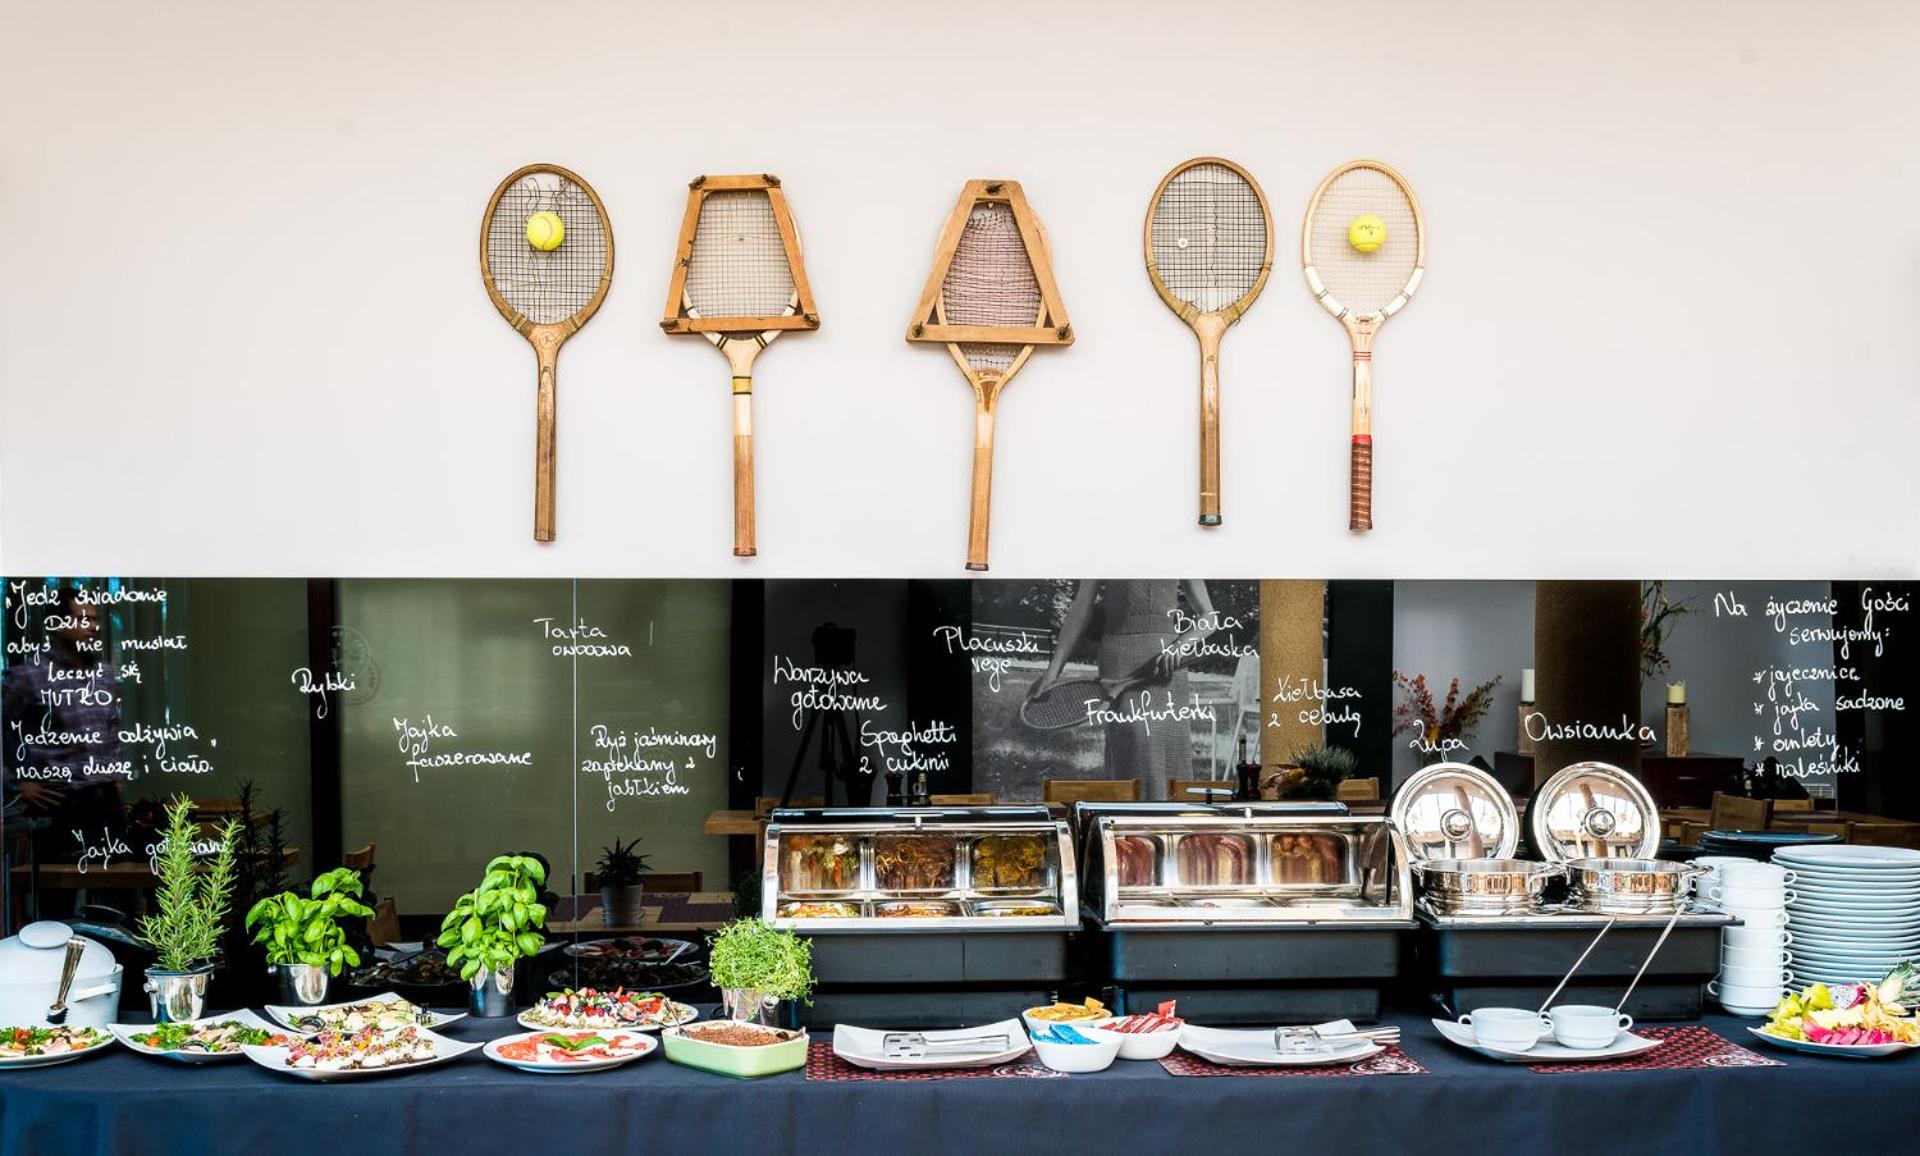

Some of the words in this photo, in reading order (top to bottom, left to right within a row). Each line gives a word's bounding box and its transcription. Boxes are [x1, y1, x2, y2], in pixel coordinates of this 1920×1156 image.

[74, 584, 168, 606] świadomie
[1714, 591, 1749, 617] Na
[1861, 587, 1911, 633] Gości
[533, 617, 609, 639] Tarta
[1166, 608, 1245, 634] Biała
[7, 636, 52, 665] abyś
[76, 638, 104, 652] nie
[121, 635, 188, 651] musiał
[552, 645, 633, 658] owocowa
[933, 625, 1040, 654] Placuszki
[1160, 633, 1260, 659] kiełbaska
[47, 661, 104, 696] leczyć
[120, 660, 143, 684] się
[773, 655, 870, 693] Warzywa
[971, 657, 1012, 693] vege
[1273, 675, 1363, 702] Kiełbasa
[291, 667, 357, 719] Rybki
[790, 684, 888, 731] gotowane
[1084, 690, 1217, 736] Frankfurterki
[1524, 712, 1658, 743] Owsianka
[1773, 691, 1821, 735] jajka
[1835, 688, 1906, 711] sadzone
[11, 720, 104, 760] Jedzenie
[392, 714, 458, 753] Jajka
[590, 724, 628, 762] Ryż
[634, 725, 717, 763] jaśminowy
[860, 719, 957, 757] Spaghetti
[1409, 719, 1470, 763] Zupa
[1773, 726, 1841, 760] omlety
[16, 766, 73, 782] naszą
[83, 756, 135, 780] duszę
[142, 755, 150, 774] i
[405, 743, 534, 783] faszerowane
[581, 754, 676, 785] zapiekany
[886, 751, 950, 773] cukinii
[1776, 746, 1861, 779] naleśniki
[606, 778, 690, 812] jabłkiem
[71, 826, 134, 874] Jajka
